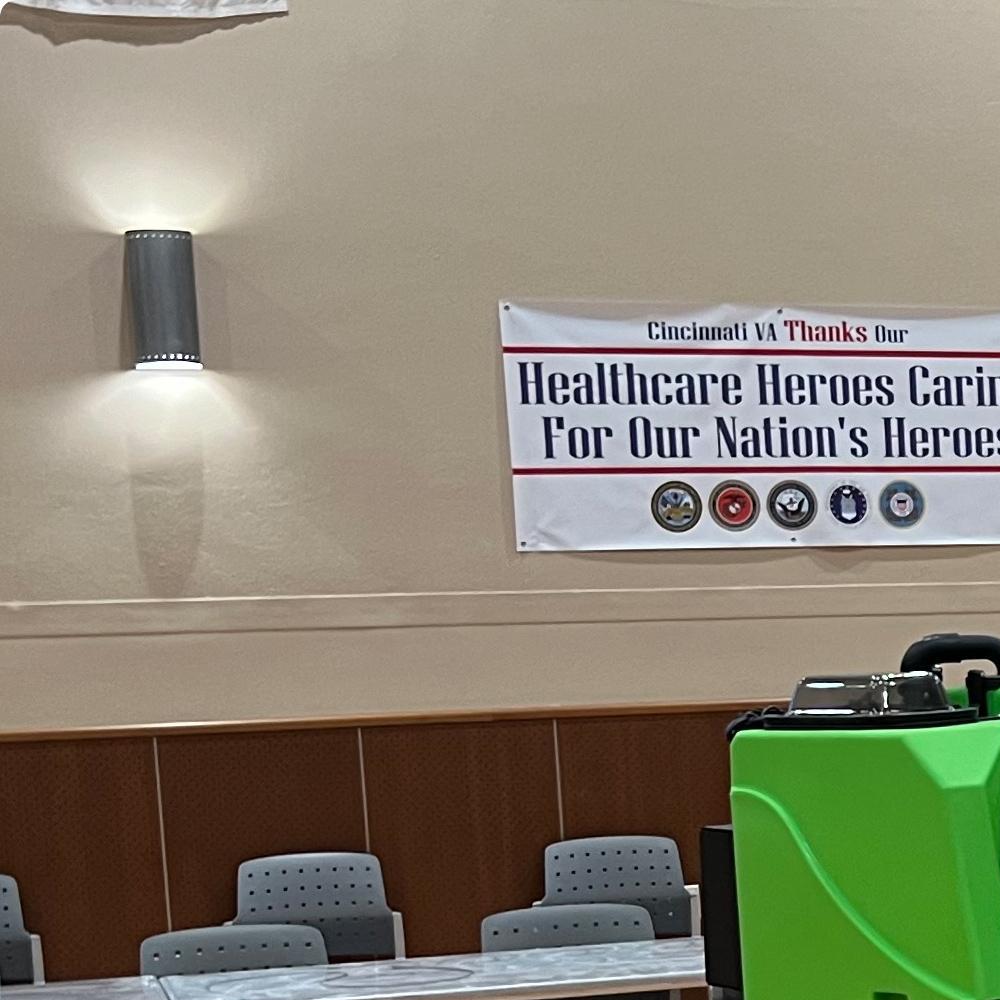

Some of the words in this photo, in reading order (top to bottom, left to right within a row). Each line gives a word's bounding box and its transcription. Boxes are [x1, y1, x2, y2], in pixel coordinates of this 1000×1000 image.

[647, 321, 747, 342] Cincinnati
[754, 322, 778, 342] VA
[783, 319, 868, 344] Thanks
[874, 324, 909, 344] Our
[517, 361, 742, 407] Healthcare
[756, 363, 895, 407] Heroes
[542, 416, 614, 460] For
[628, 415, 701, 460] Our
[714, 415, 869, 460] Nation's
